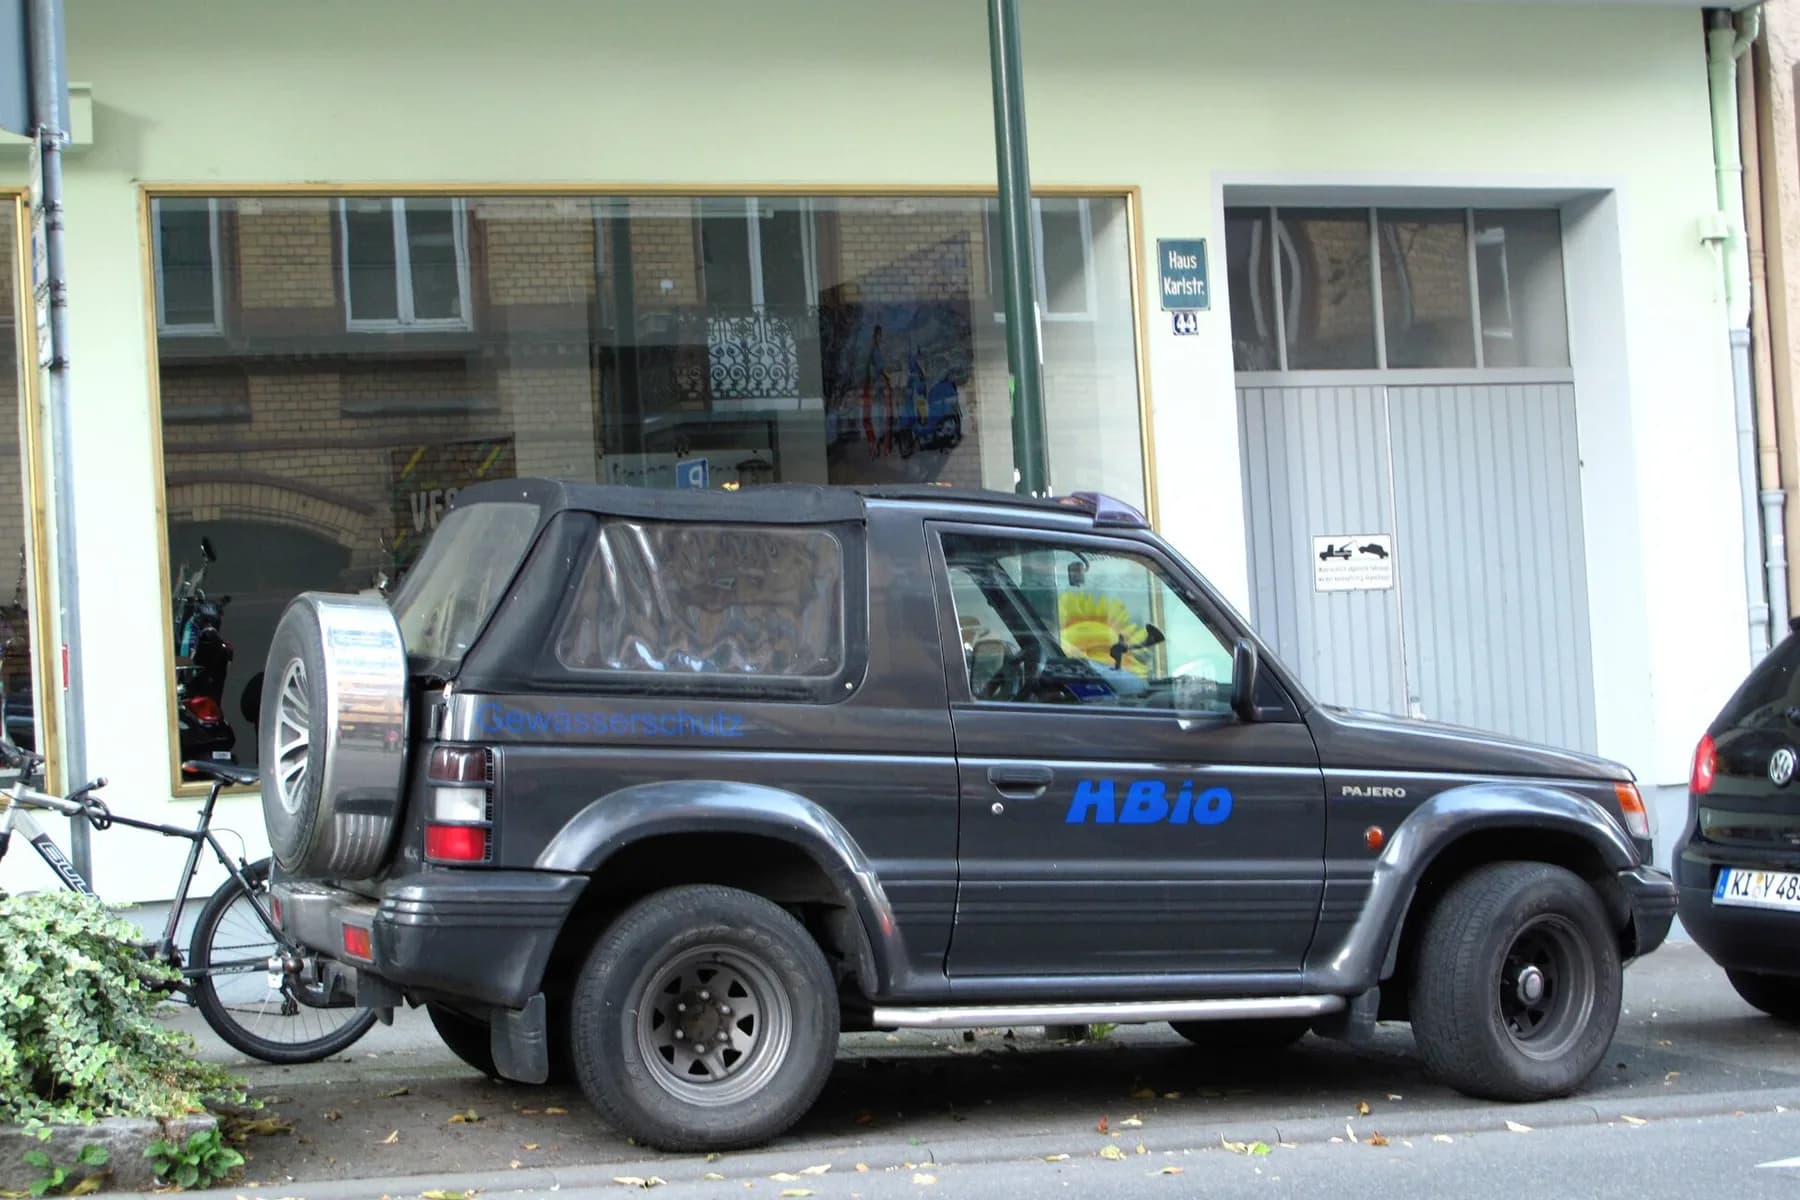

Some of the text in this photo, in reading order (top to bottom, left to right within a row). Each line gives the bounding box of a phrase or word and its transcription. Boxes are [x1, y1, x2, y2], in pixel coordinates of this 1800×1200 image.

[1168, 250, 1197, 270] Haus
[1164, 276, 1205, 296] Karlstr.
[1175, 312, 1196, 333] 44
[477, 702, 744, 737] Gewässerschutz
[1065, 779, 1233, 825] HBio
[1341, 785, 1406, 798] PAJERO
[1731, 871, 1800, 901] KI Y 48
